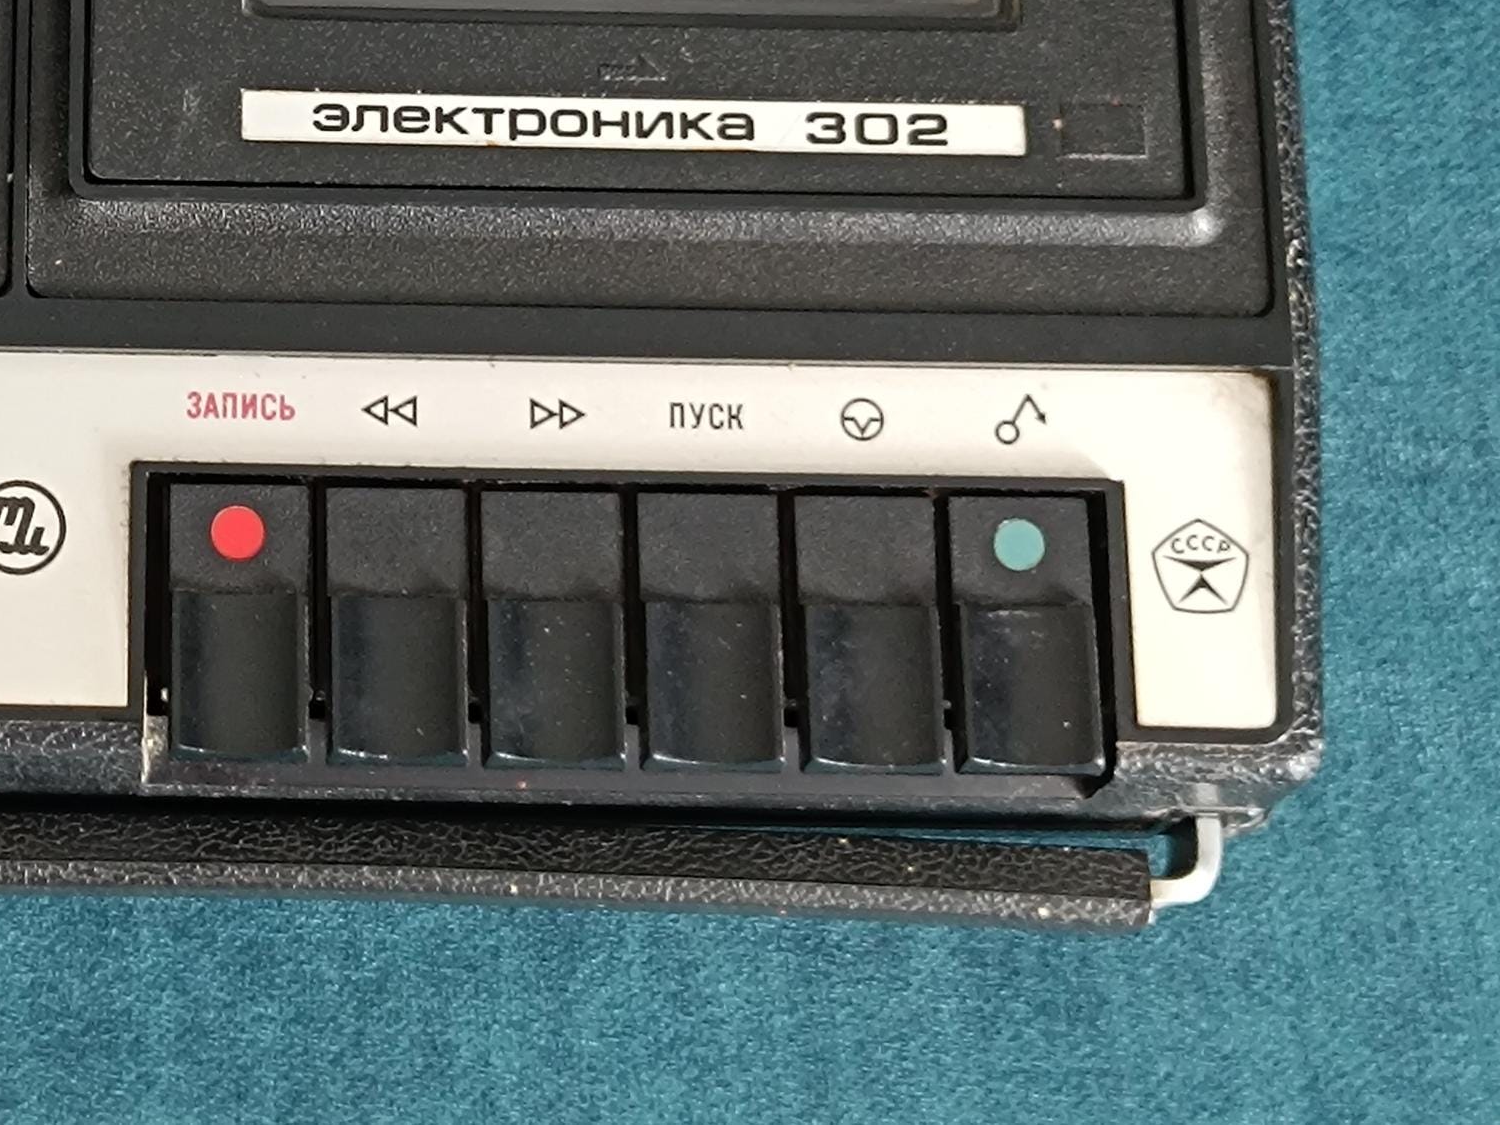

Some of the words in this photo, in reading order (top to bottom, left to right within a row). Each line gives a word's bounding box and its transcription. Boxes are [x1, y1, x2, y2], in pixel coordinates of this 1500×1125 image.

[312, 101, 755, 142] электроника
[805, 111, 950, 147] 302
[186, 391, 296, 422] ЗАПИСЬ
[669, 401, 745, 431] ПУСК
[1170, 534, 1231, 555] СССР
